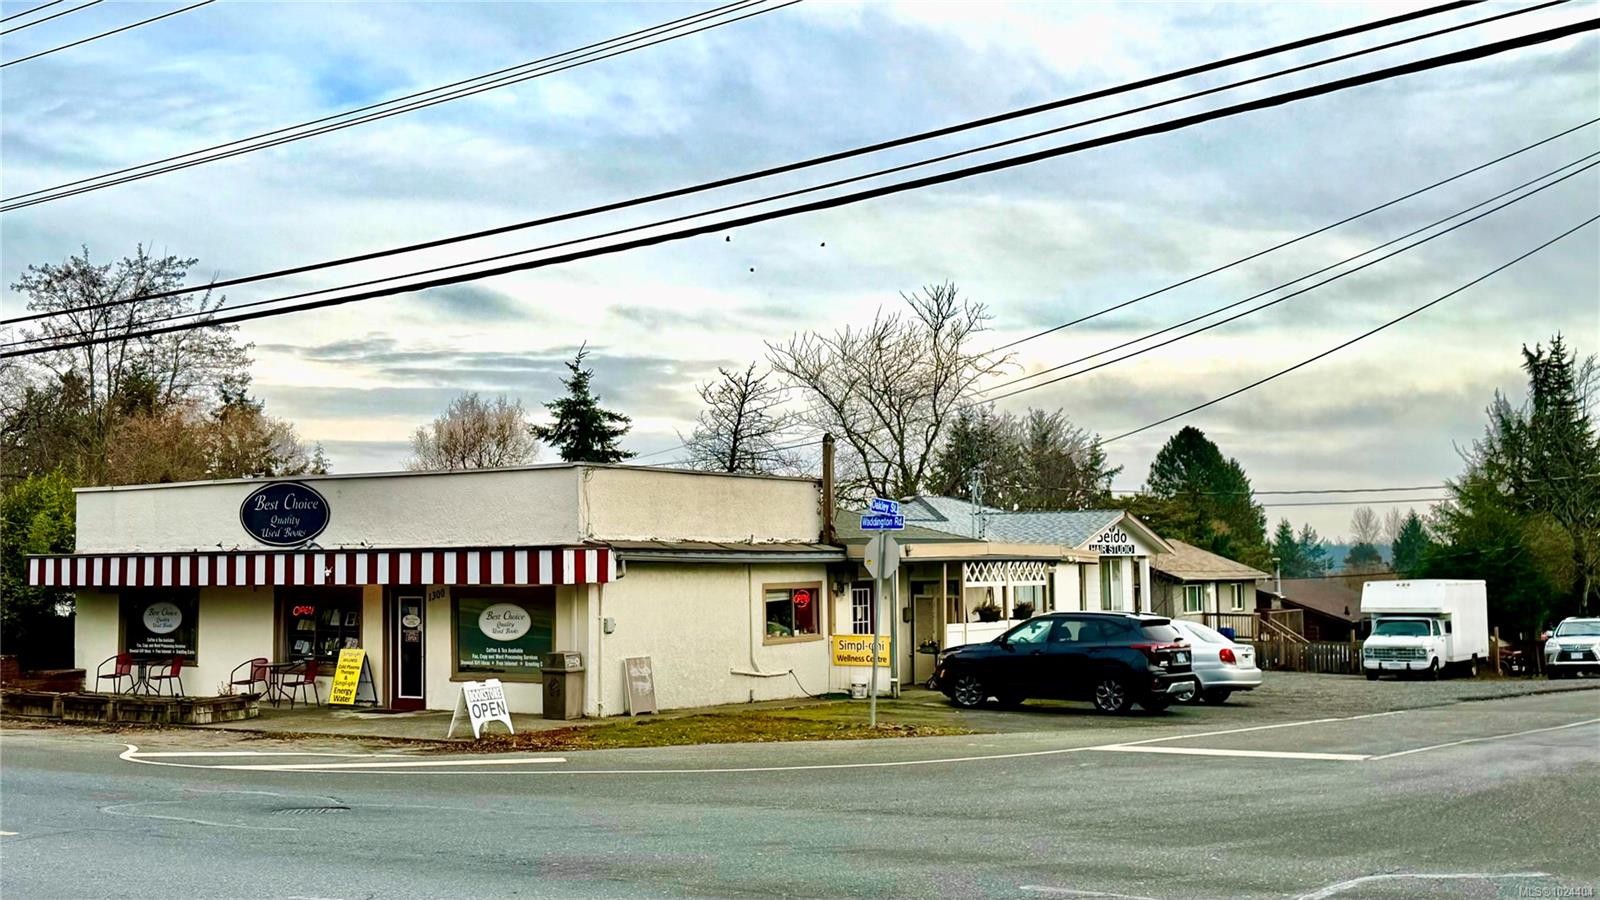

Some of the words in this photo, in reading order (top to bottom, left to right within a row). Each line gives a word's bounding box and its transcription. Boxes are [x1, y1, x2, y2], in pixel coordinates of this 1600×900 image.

[254, 495, 279, 511] Best
[284, 493, 319, 510] Choice
[871, 499, 889, 513] Oakley
[270, 515, 300, 528] Quality
[862, 517, 893, 528] Waddington
[260, 528, 281, 538] Used
[284, 527, 307, 538] Books
[1108, 544, 1133, 554] STUDIO
[428, 588, 446, 602] 1300
[486, 611, 501, 620] Best
[503, 610, 526, 620] Choice
[836, 654, 865, 662] Wellness
[866, 655, 888, 663] Cetre
[333, 687, 353, 696] Energy
[472, 701, 507, 719] OPEN
